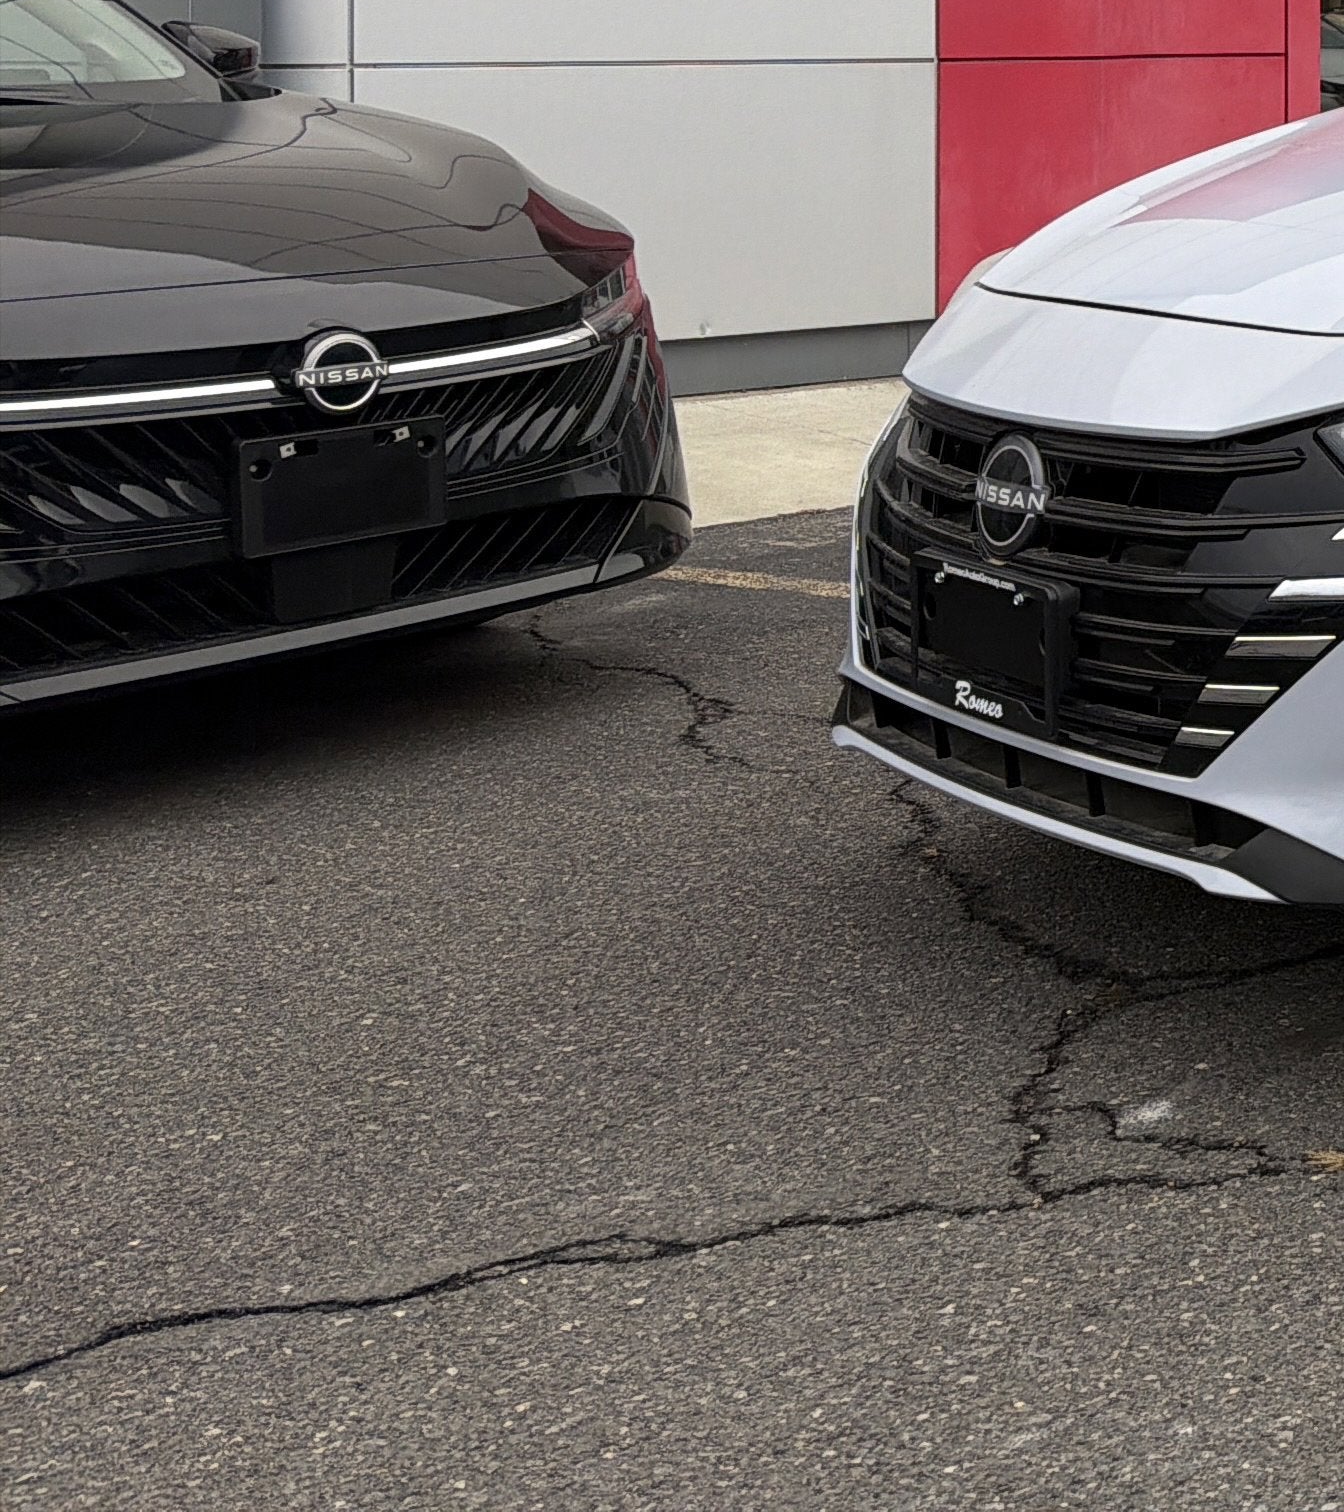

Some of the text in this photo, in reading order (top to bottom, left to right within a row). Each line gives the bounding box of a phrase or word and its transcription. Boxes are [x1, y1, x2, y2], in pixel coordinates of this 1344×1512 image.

[299, 363, 389, 387] NISSAN
[974, 479, 1046, 511] NISSAN
[954, 679, 1004, 719] Romeo
